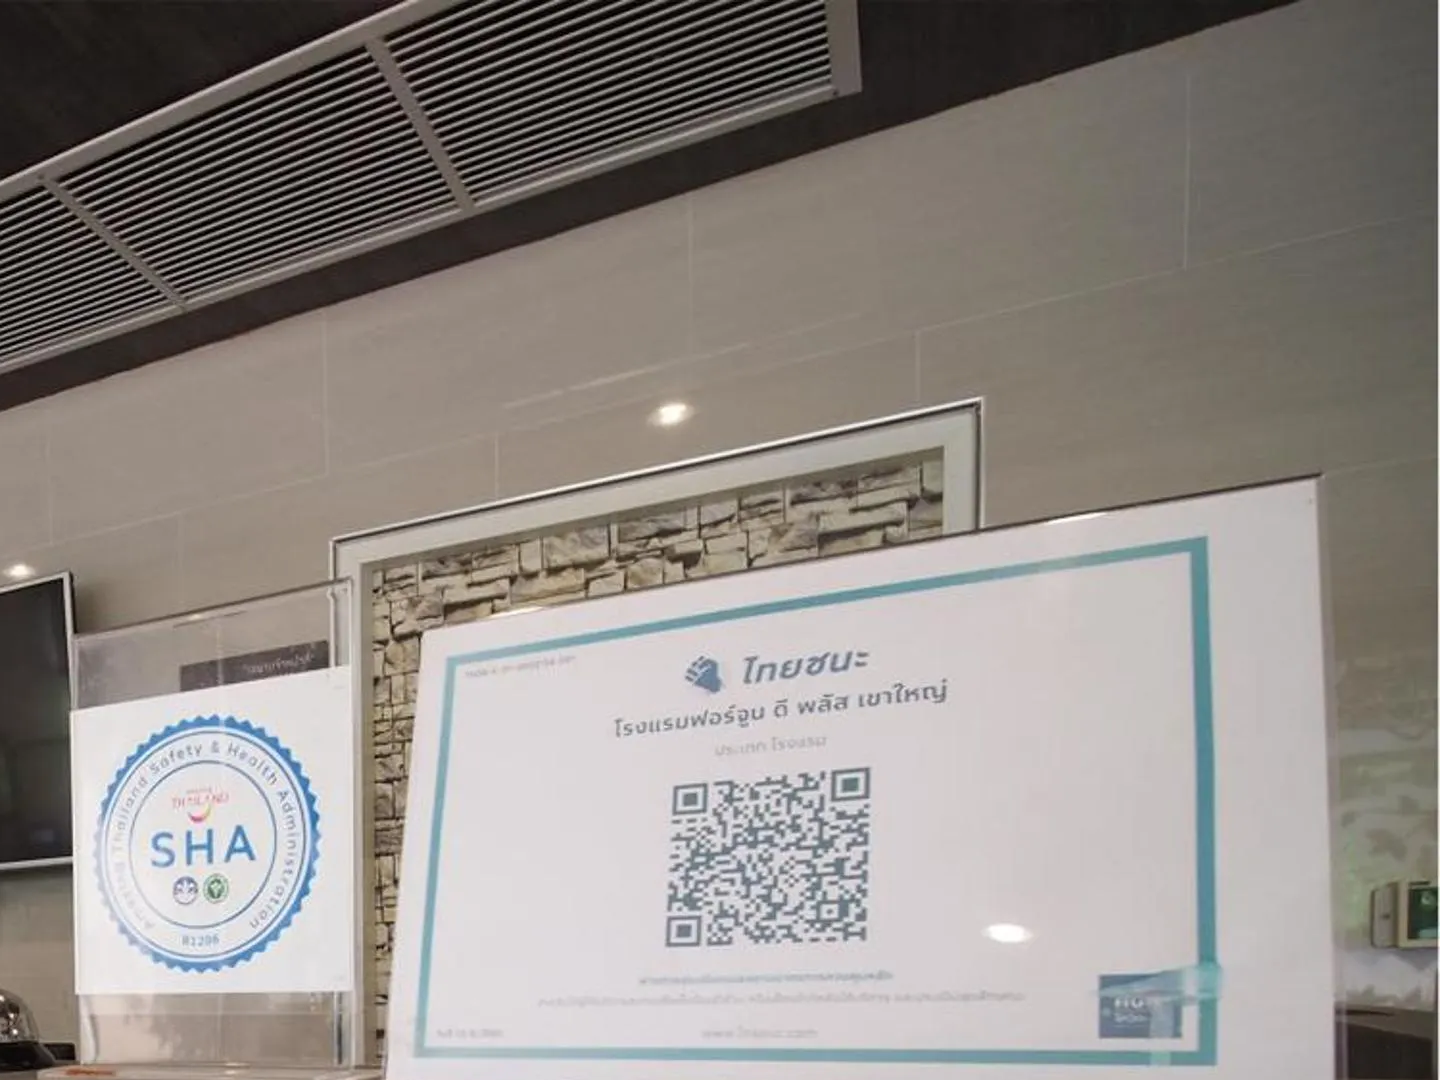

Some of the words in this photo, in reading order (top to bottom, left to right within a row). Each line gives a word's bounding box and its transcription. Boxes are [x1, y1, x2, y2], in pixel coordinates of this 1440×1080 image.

[742, 650, 870, 685] ไทยชนะ
[614, 703, 765, 738] โรงแรมฟอร์จูน
[773, 698, 789, 718] ดี
[797, 694, 849, 715] พลัส
[857, 679, 949, 708] เขาใหญ่
[149, 741, 202, 774] Safety
[209, 740, 221, 754] &
[771, 734, 827, 750] โรงแรม
[228, 743, 279, 786] Health
[150, 824, 257, 868] SHA
[249, 790, 298, 930] Administration
